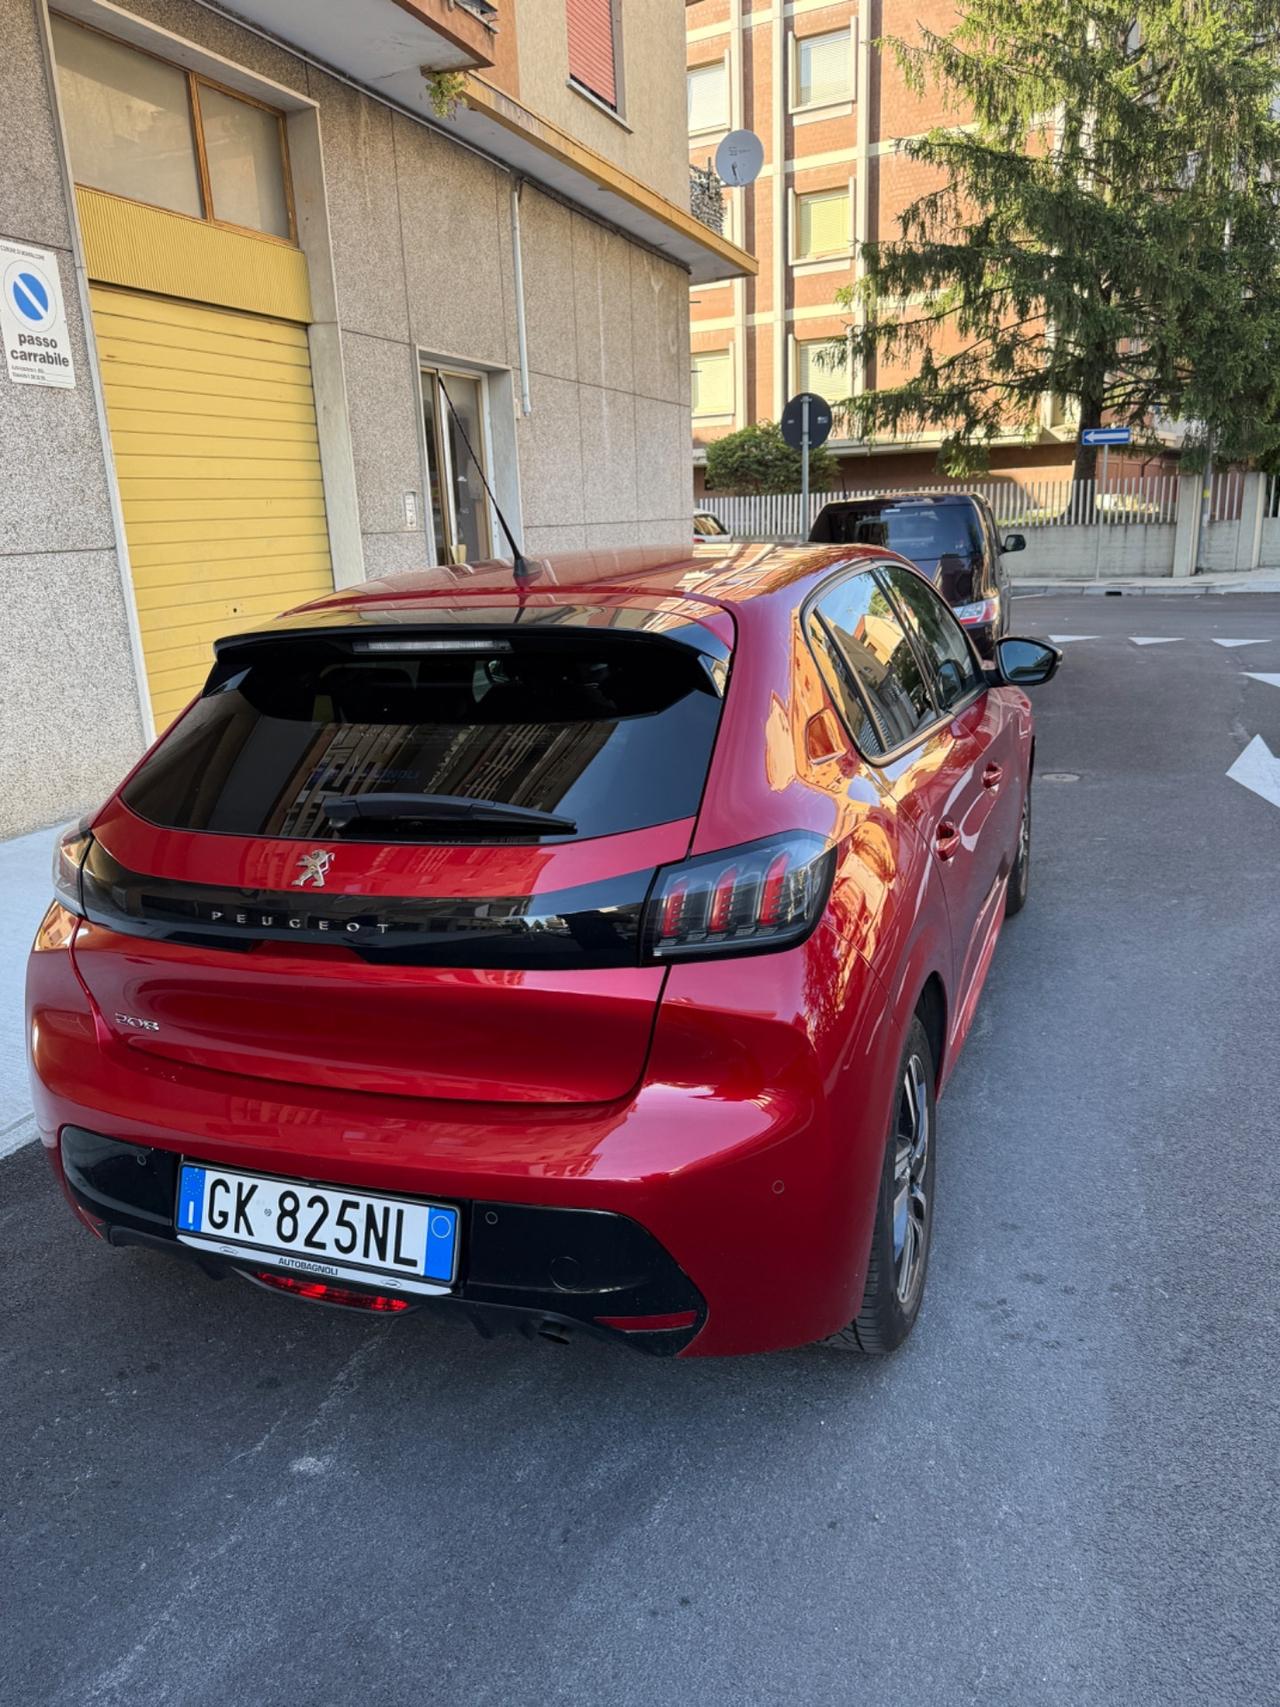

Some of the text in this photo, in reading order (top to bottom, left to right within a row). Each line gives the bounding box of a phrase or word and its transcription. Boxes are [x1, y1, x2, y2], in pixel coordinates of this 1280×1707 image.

[18, 333, 58, 349] passo
[10, 349, 70, 367] carrabile
[211, 910, 389, 934] PEUGEOT
[115, 1012, 160, 1031] 208
[208, 1178, 418, 1268] GK 825NL
[278, 1257, 339, 1276] AUTOBAGNOLI
